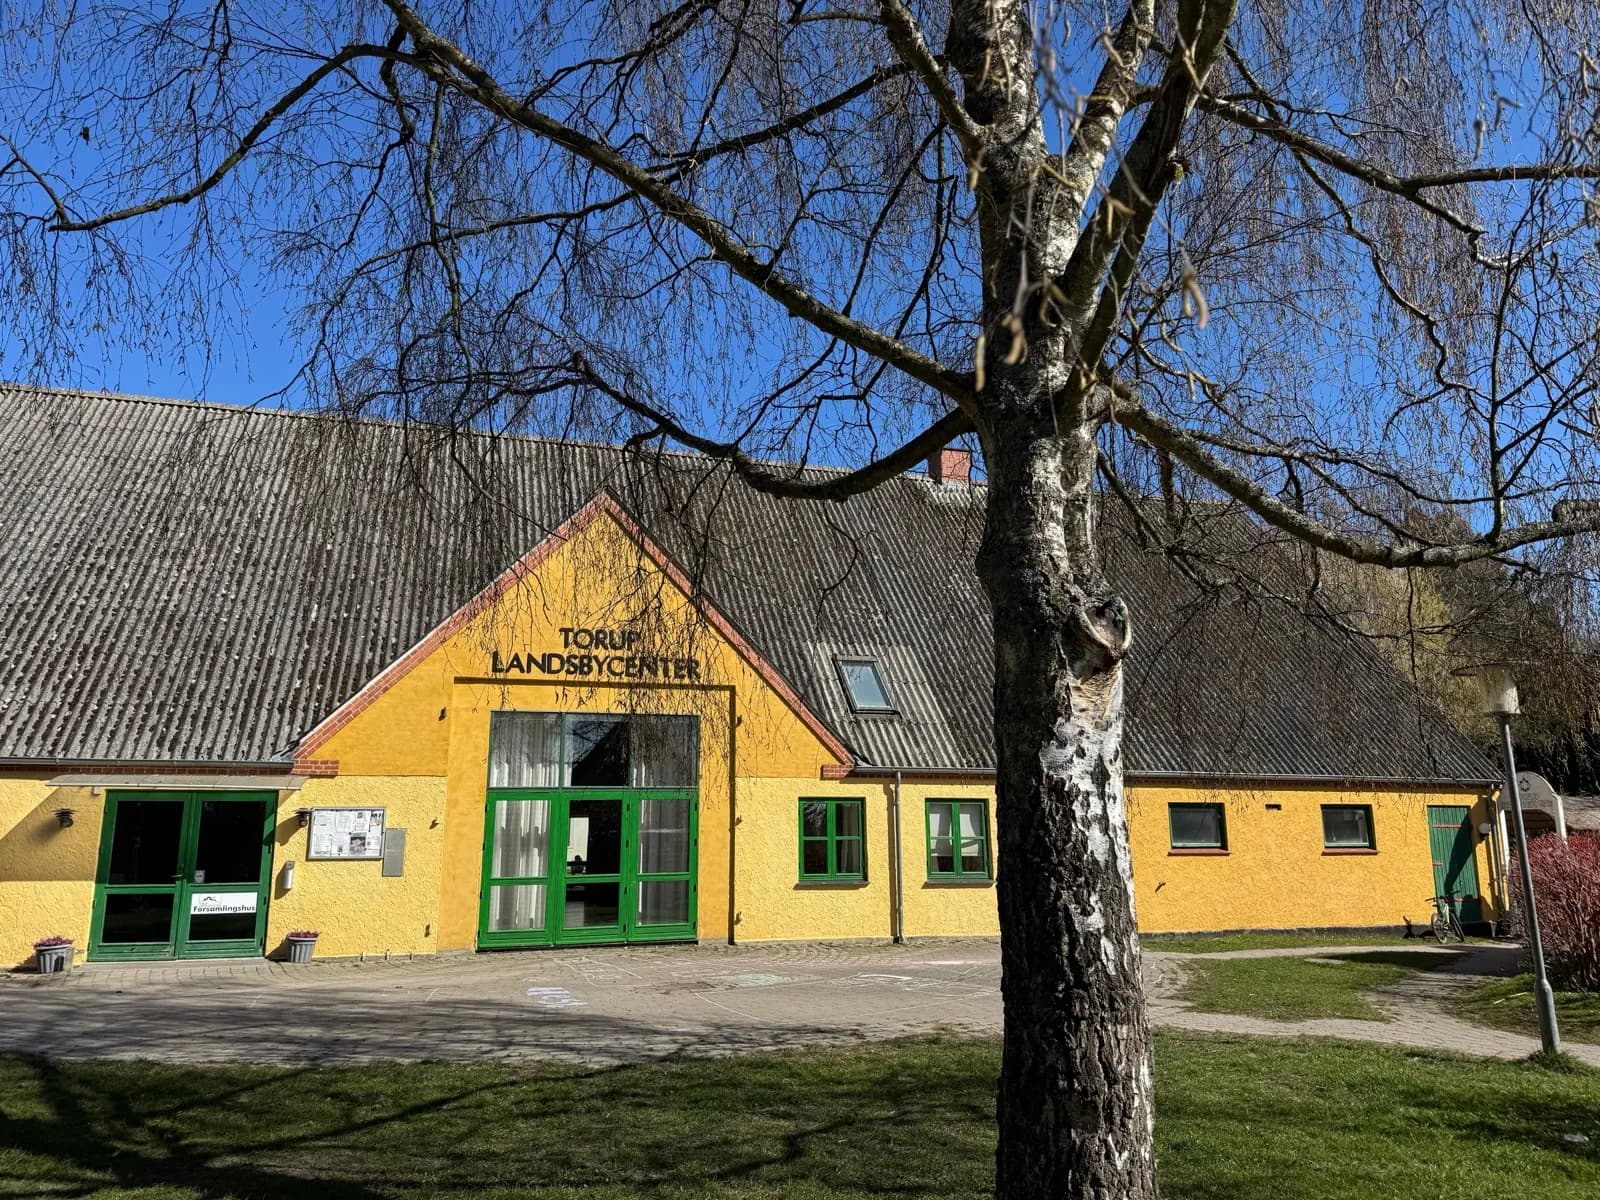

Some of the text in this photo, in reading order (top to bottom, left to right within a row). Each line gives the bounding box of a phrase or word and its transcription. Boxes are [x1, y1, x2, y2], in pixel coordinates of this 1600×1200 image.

[558, 628, 640, 651] TORUP
[491, 651, 701, 679] LANDSBYCENTER
[193, 905, 256, 913] Forsamlingshus
